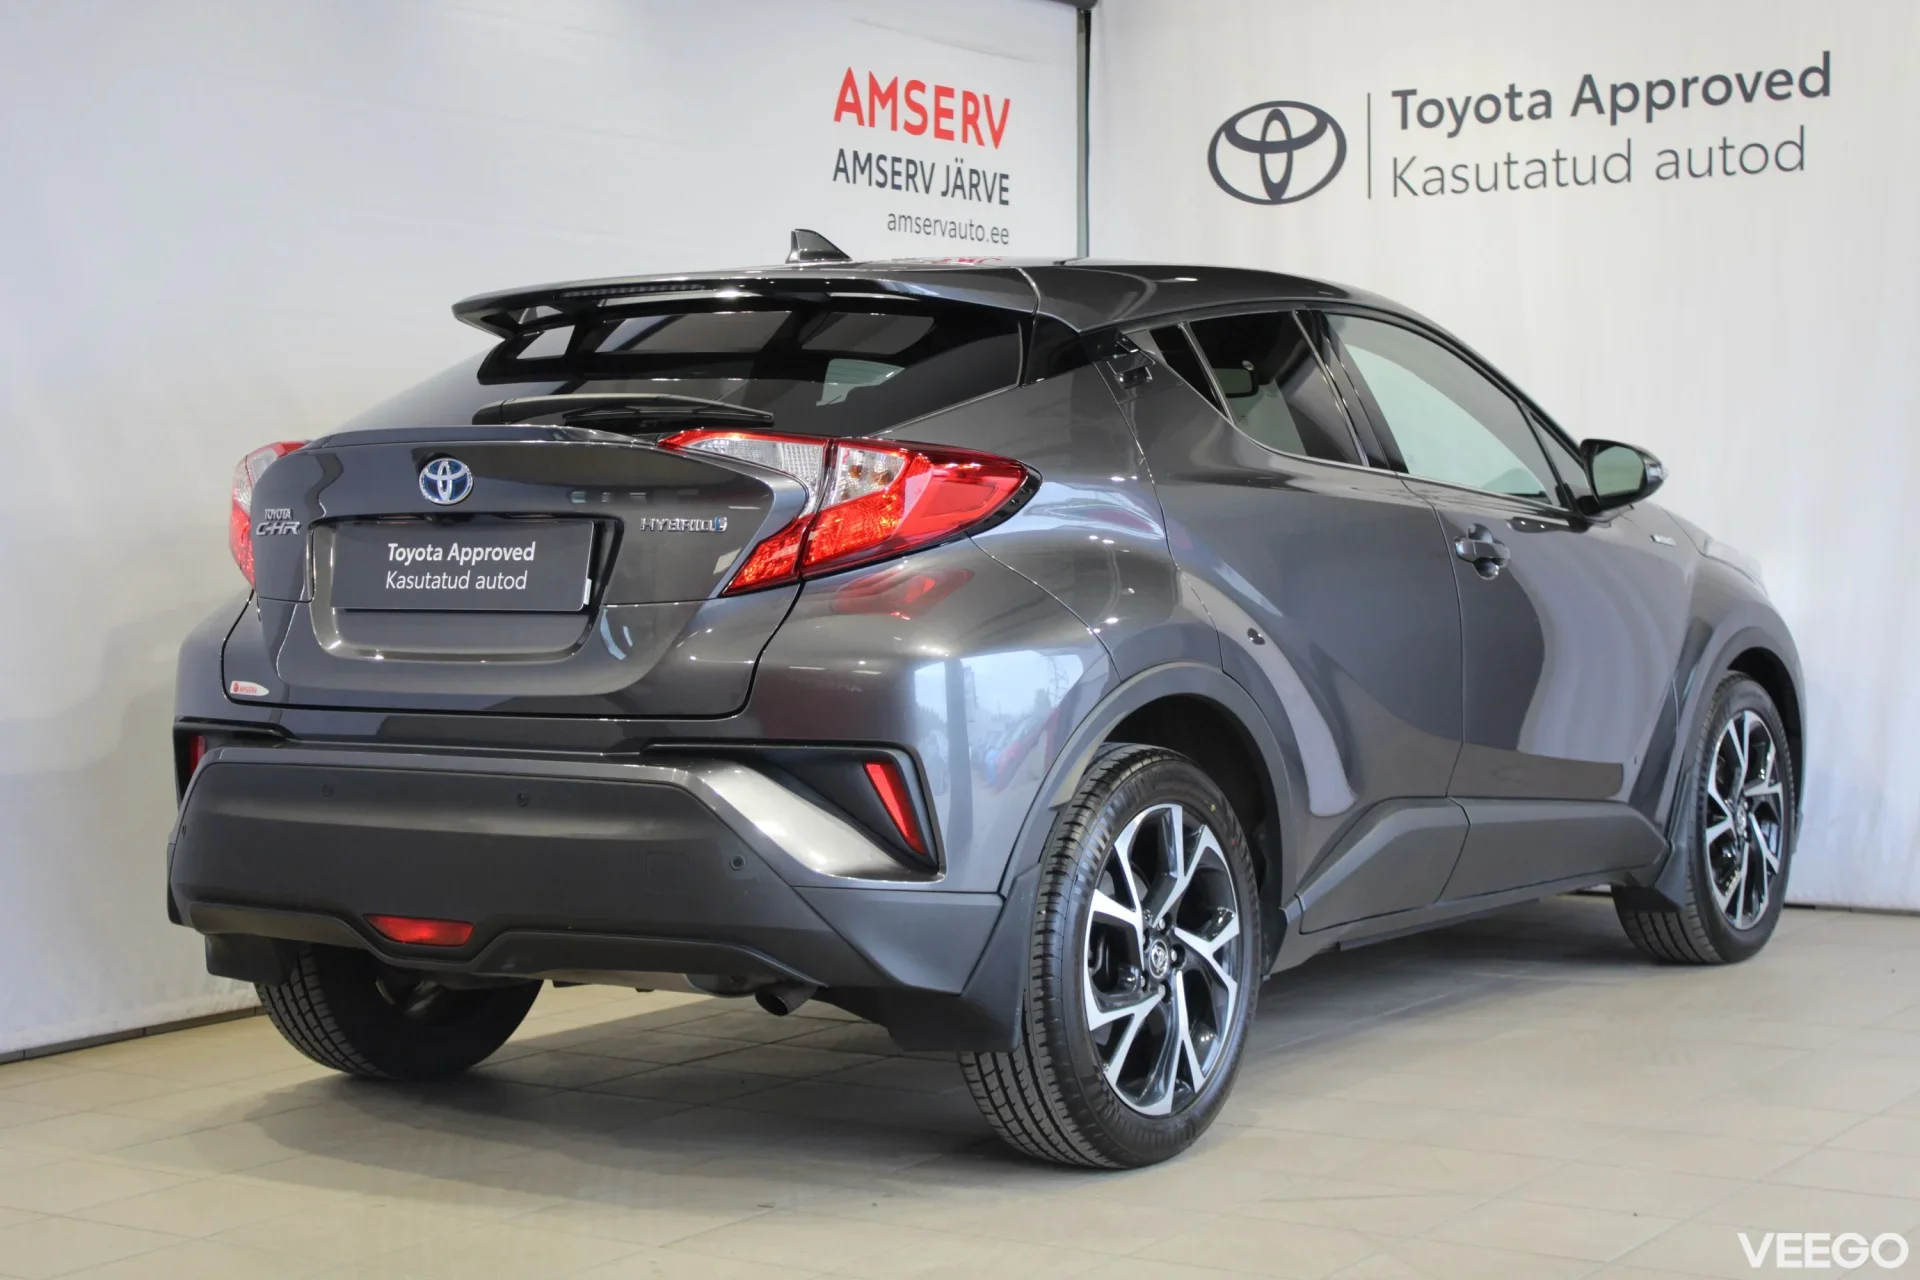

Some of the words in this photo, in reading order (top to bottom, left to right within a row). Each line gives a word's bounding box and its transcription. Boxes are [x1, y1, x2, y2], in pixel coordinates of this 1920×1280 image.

[833, 66, 1011, 150] AMSERV
[1391, 83, 1553, 138] Toyota
[1569, 50, 1832, 126] Approved
[832, 147, 936, 195] AMSERV
[940, 157, 1010, 206] JÄRVE
[1392, 138, 1633, 198] Kasutatud
[1654, 125, 1806, 180] autod
[887, 212, 1010, 245] amservauto.ee
[264, 508, 291, 520] TOYOTA
[640, 517, 714, 532] HYBRID
[387, 543, 443, 566] Toyota
[446, 541, 537, 566] Approved
[385, 570, 471, 590] Kasutatud
[475, 570, 529, 590] autod
